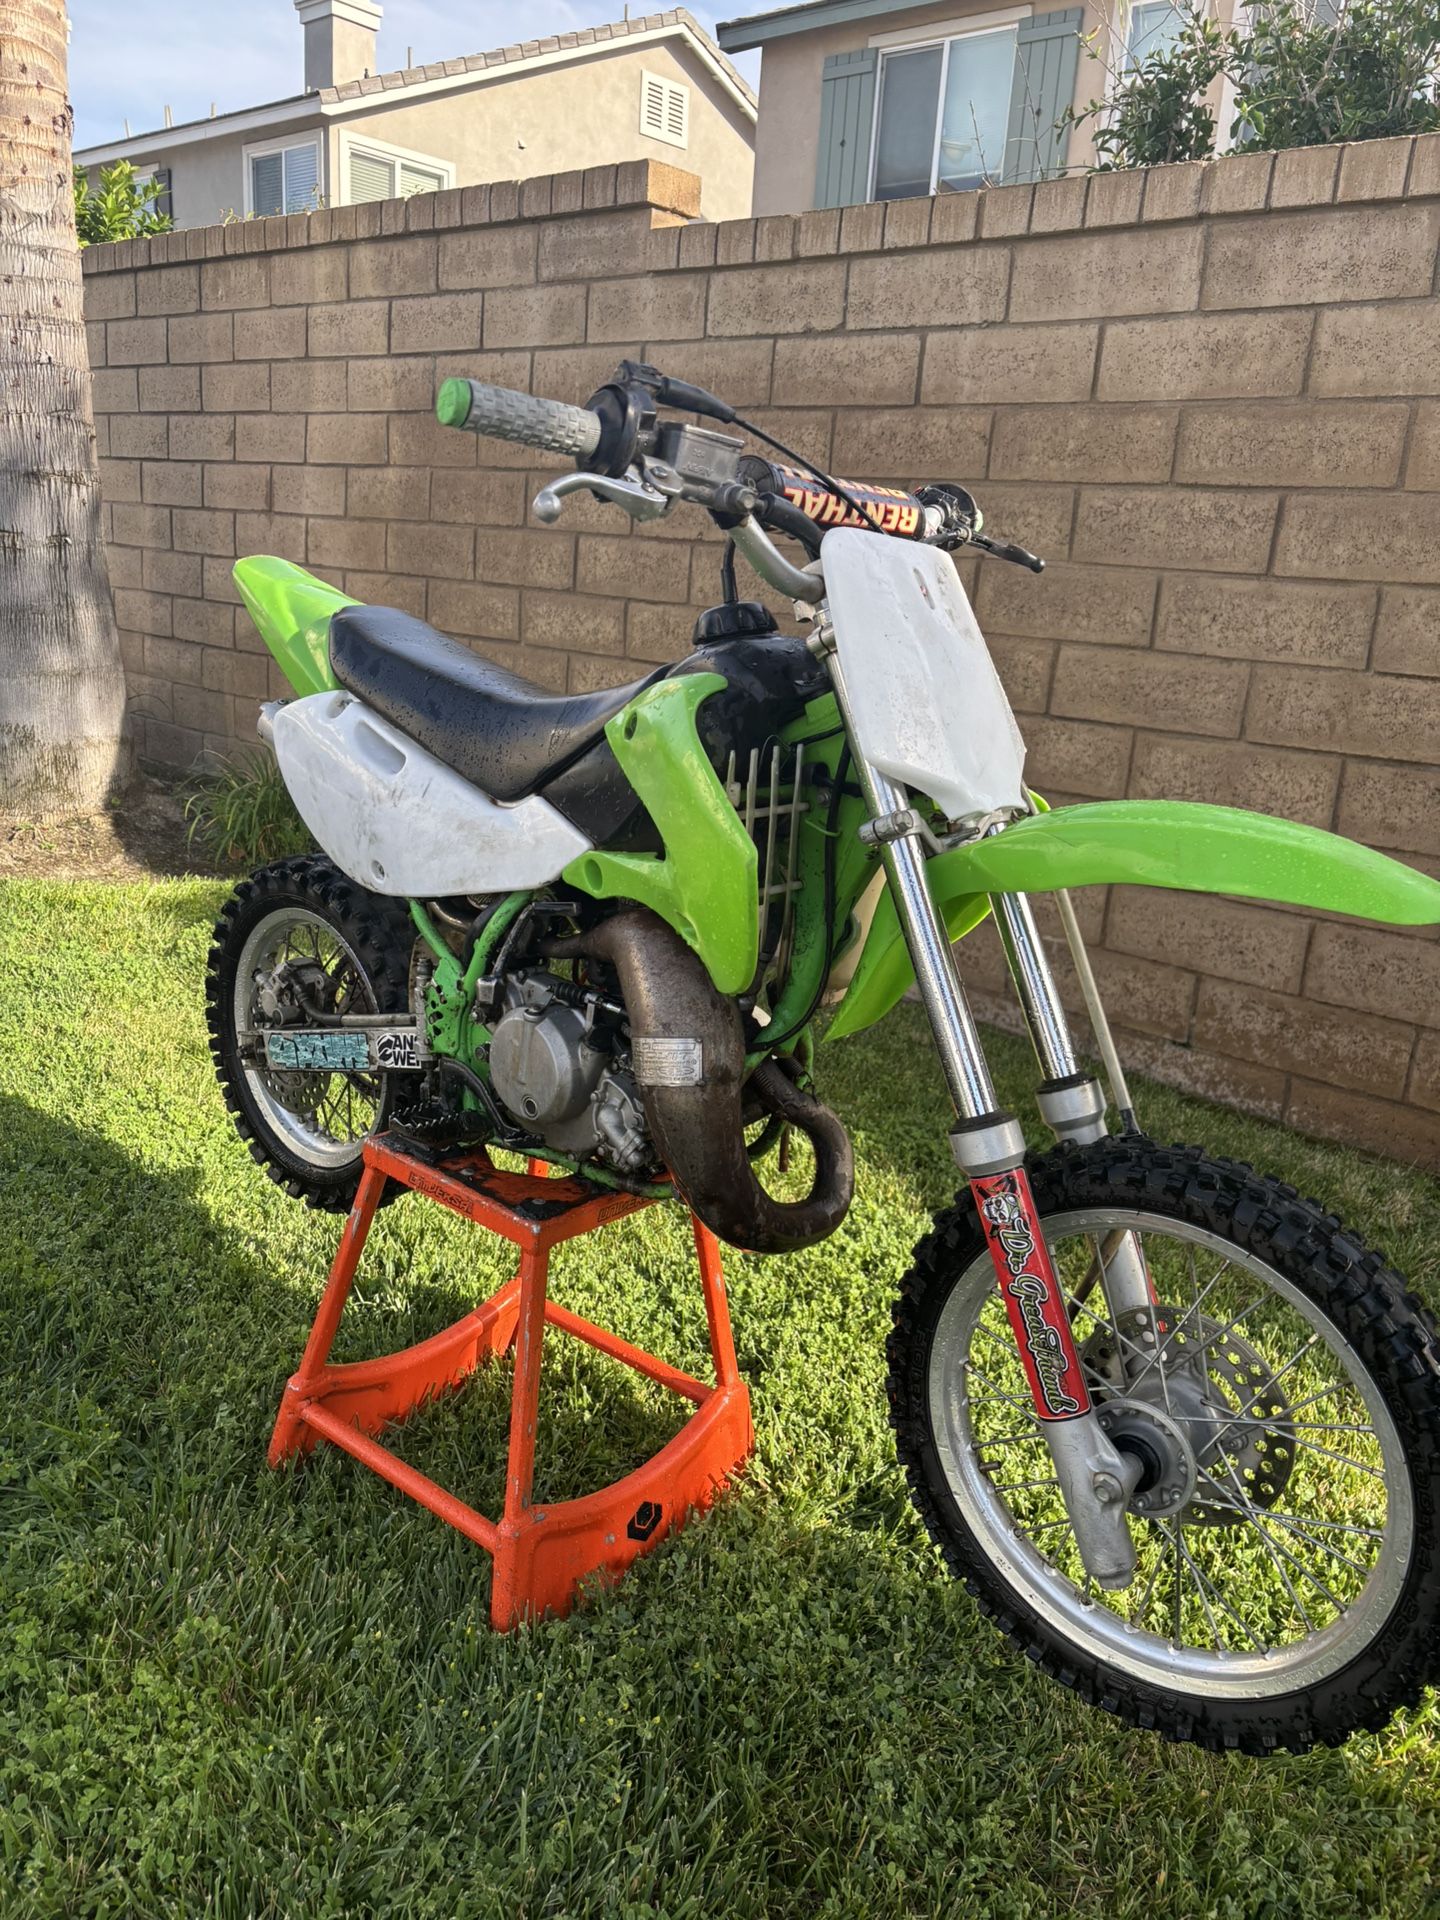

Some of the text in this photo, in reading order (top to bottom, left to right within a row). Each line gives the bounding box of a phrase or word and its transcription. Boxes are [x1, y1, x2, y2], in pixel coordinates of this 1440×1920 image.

[785, 486, 919, 534] RENTHAL
[393, 1051, 420, 1066] WE
[1000, 1217, 1034, 1275] Dr.
